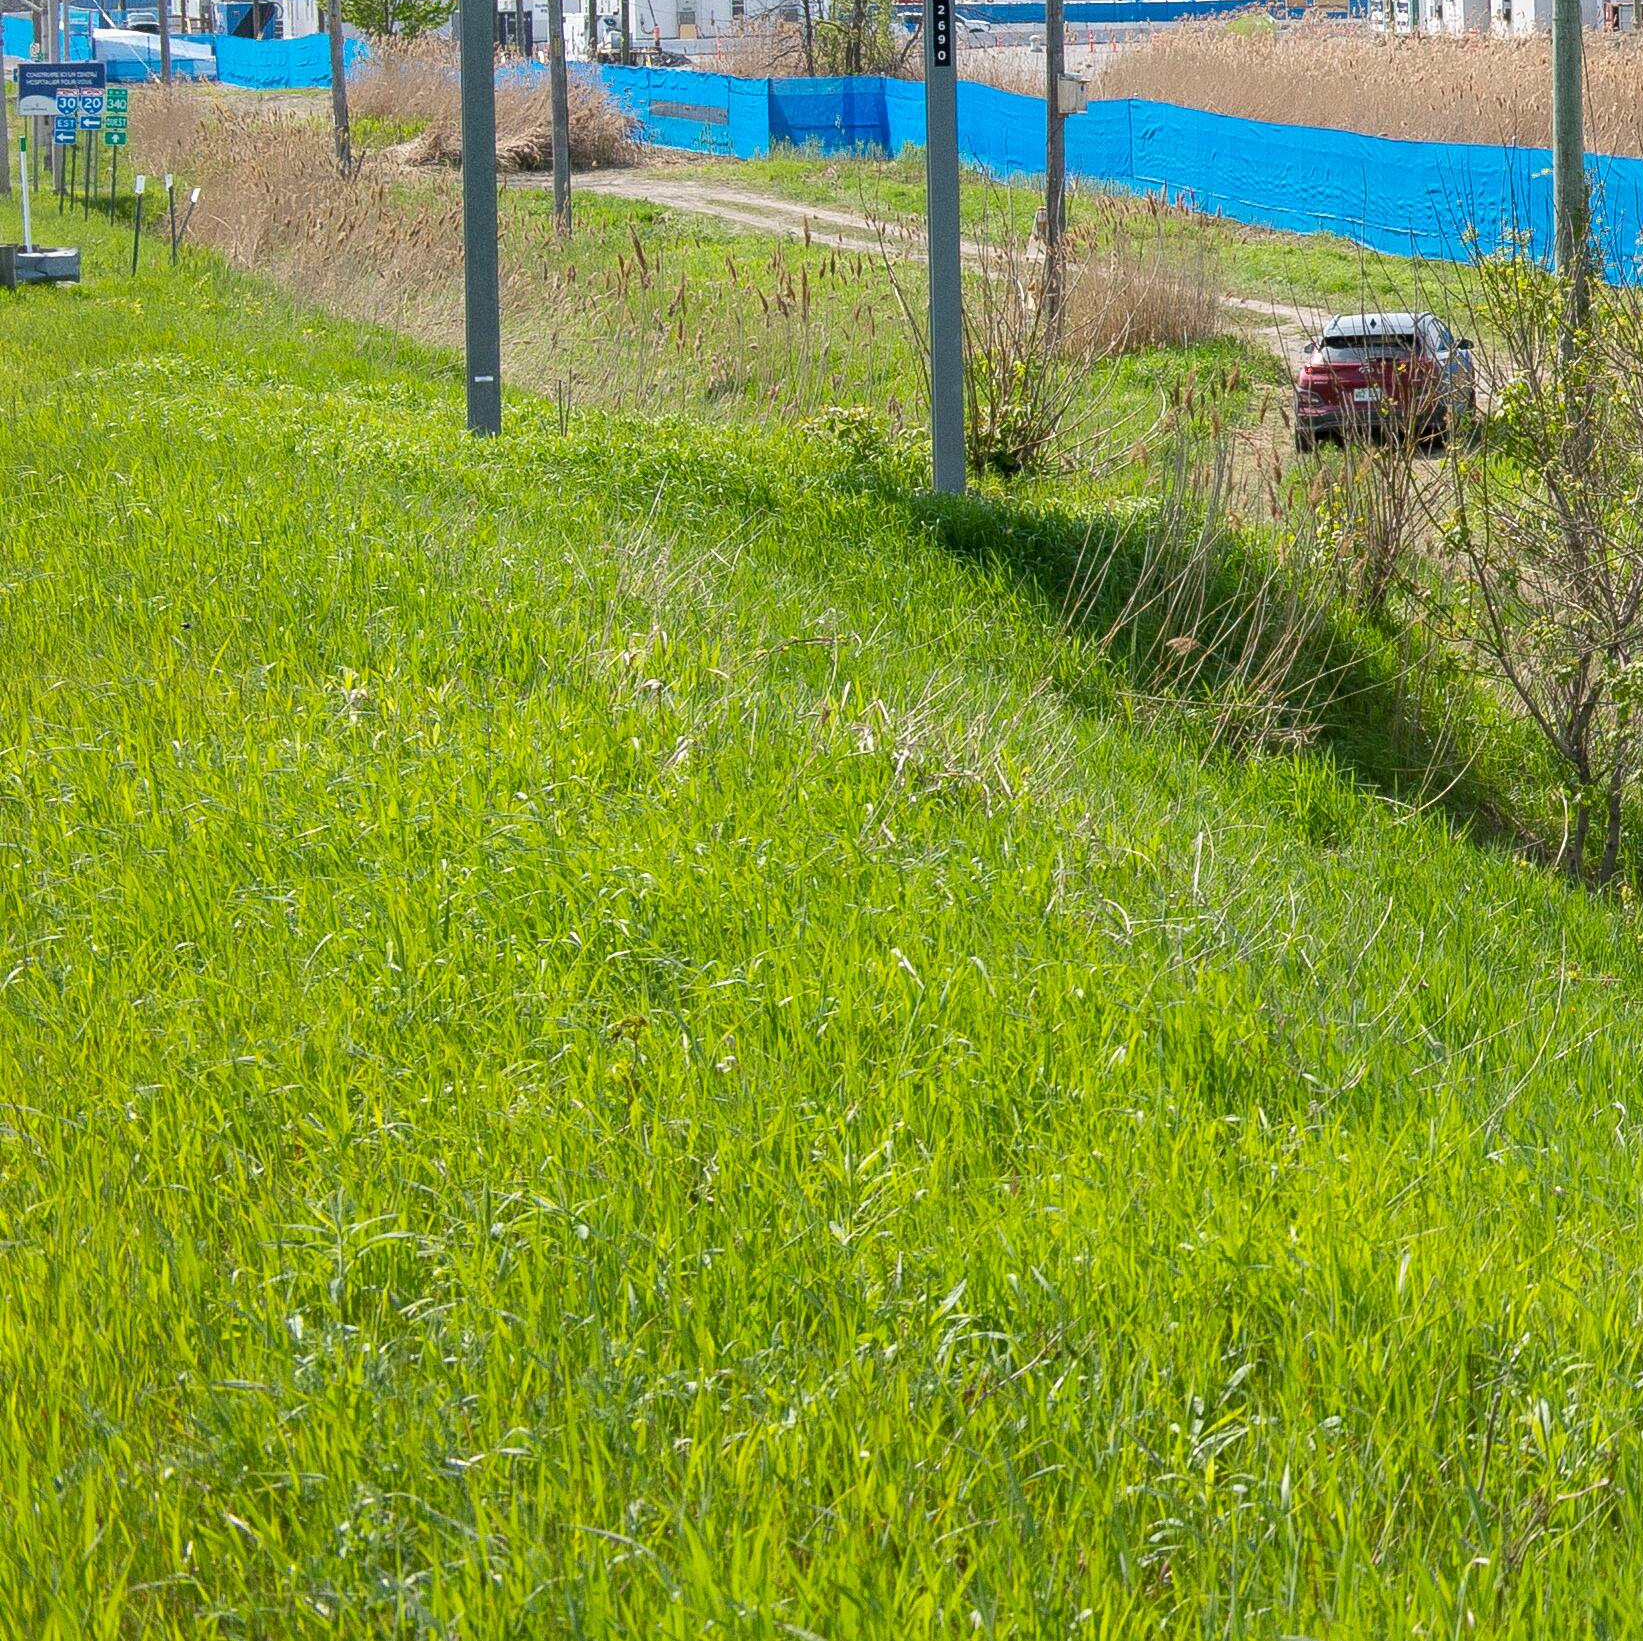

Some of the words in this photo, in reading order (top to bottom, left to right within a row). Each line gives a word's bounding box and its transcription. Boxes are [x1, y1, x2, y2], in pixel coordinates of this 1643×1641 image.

[59, 98, 76, 109] 30
[84, 98, 101, 108] 20
[107, 99, 127, 109] 340
